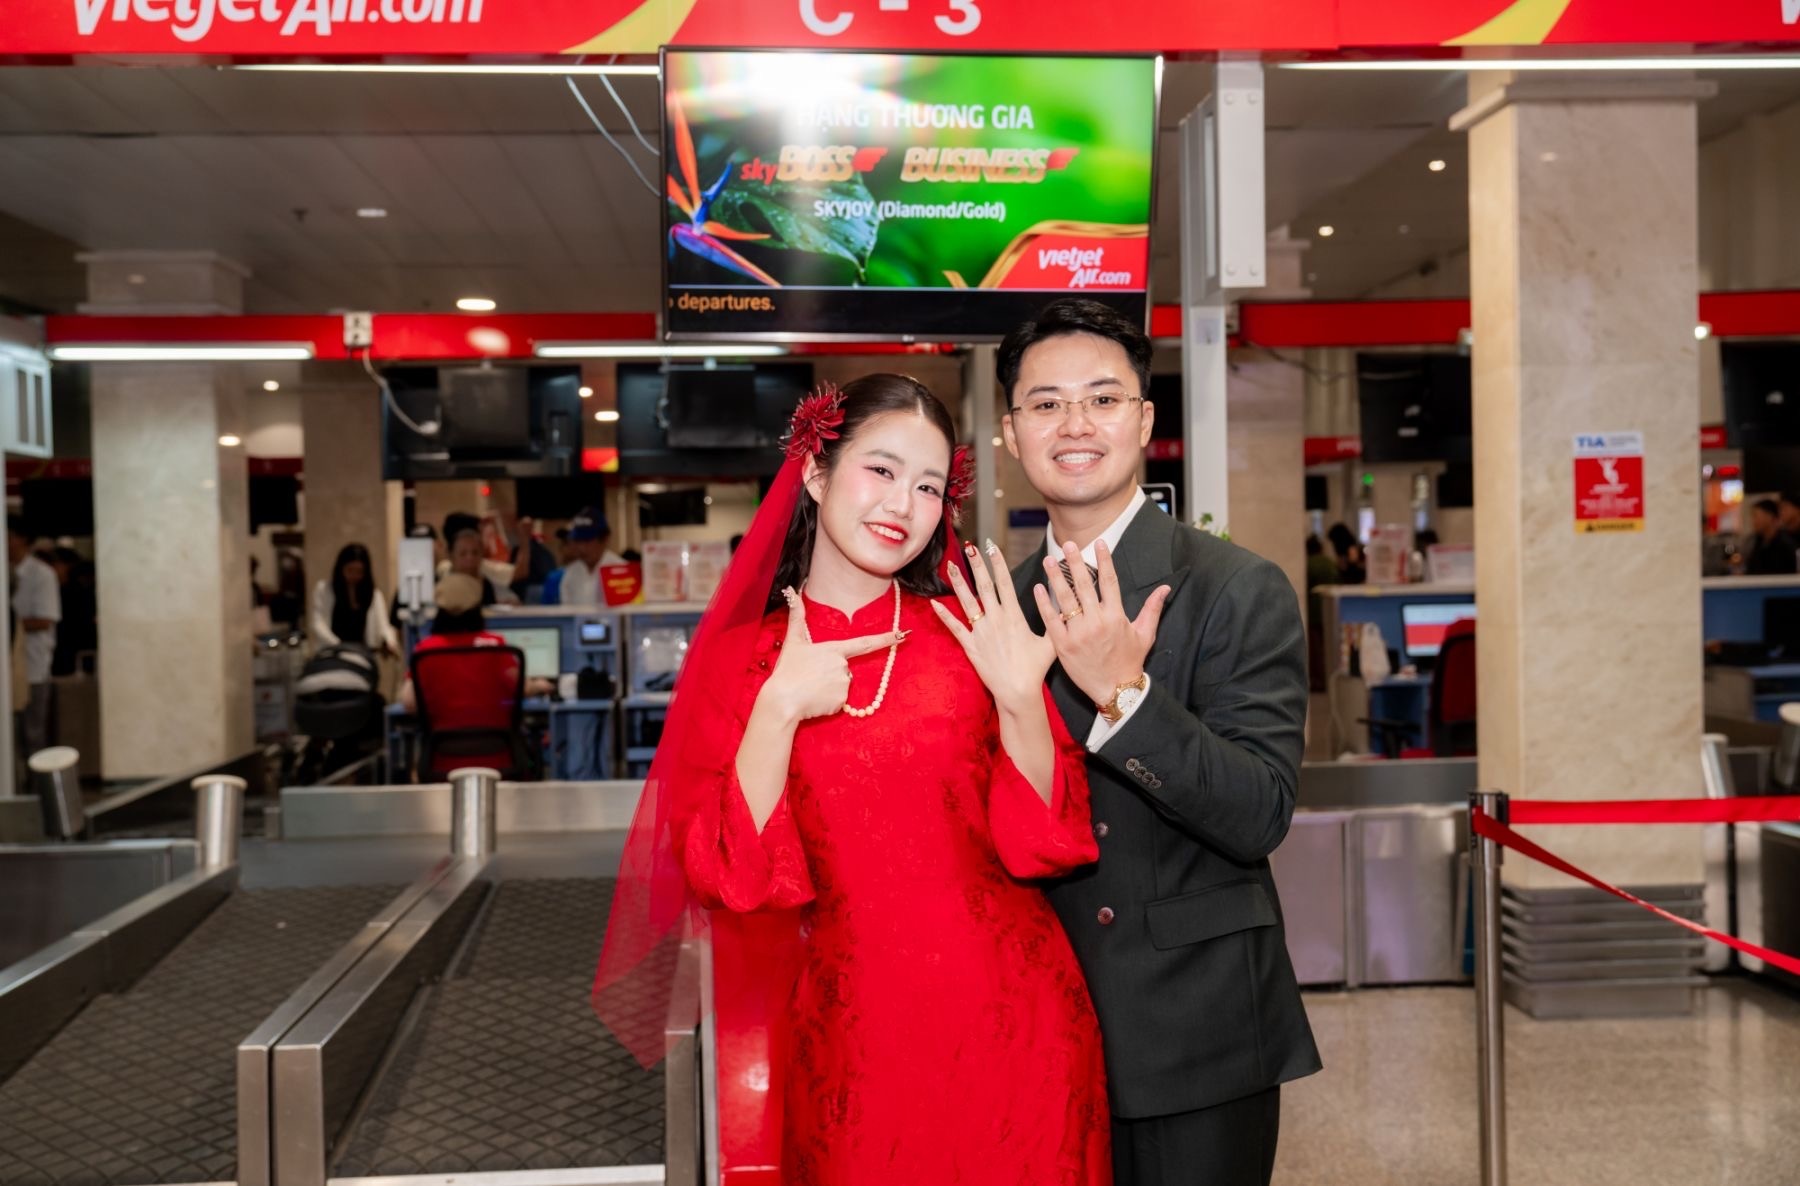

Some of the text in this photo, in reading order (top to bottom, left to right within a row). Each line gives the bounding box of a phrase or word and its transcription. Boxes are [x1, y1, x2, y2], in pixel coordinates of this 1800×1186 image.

[991, 104, 1035, 129] GIA
[900, 147, 1050, 183] BUSINESS
[813, 200, 1007, 222] SKYJOY (Diamond/Gold)
[677, 292, 776, 314] departures.
[1577, 436, 1605, 448] TIA
